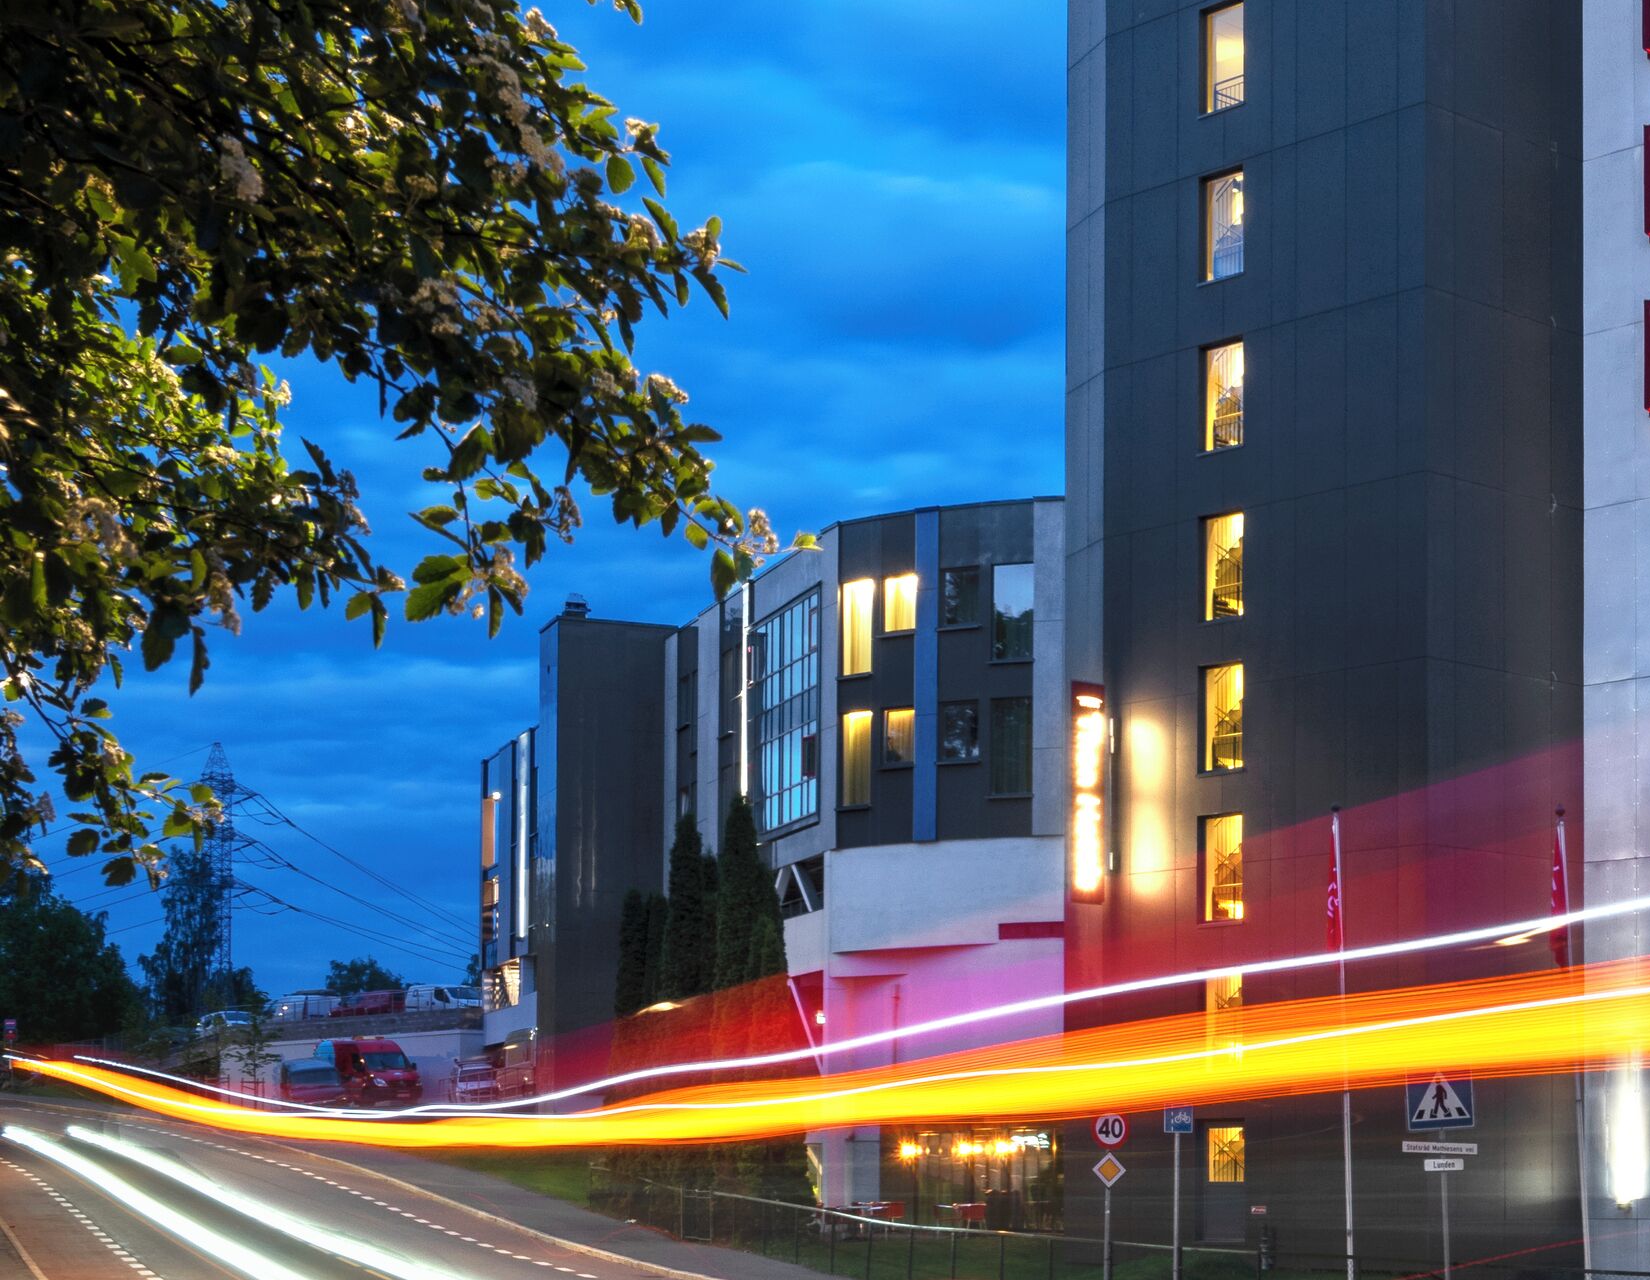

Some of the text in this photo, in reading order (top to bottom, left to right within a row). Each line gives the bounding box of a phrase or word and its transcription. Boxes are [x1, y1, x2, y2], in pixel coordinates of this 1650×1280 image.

[1098, 1118, 1123, 1139] 40
[1406, 1143, 1430, 1152] Statsråd
[1432, 1144, 1463, 1153] Mathiesens
[1433, 1161, 1455, 1169] Lunden
